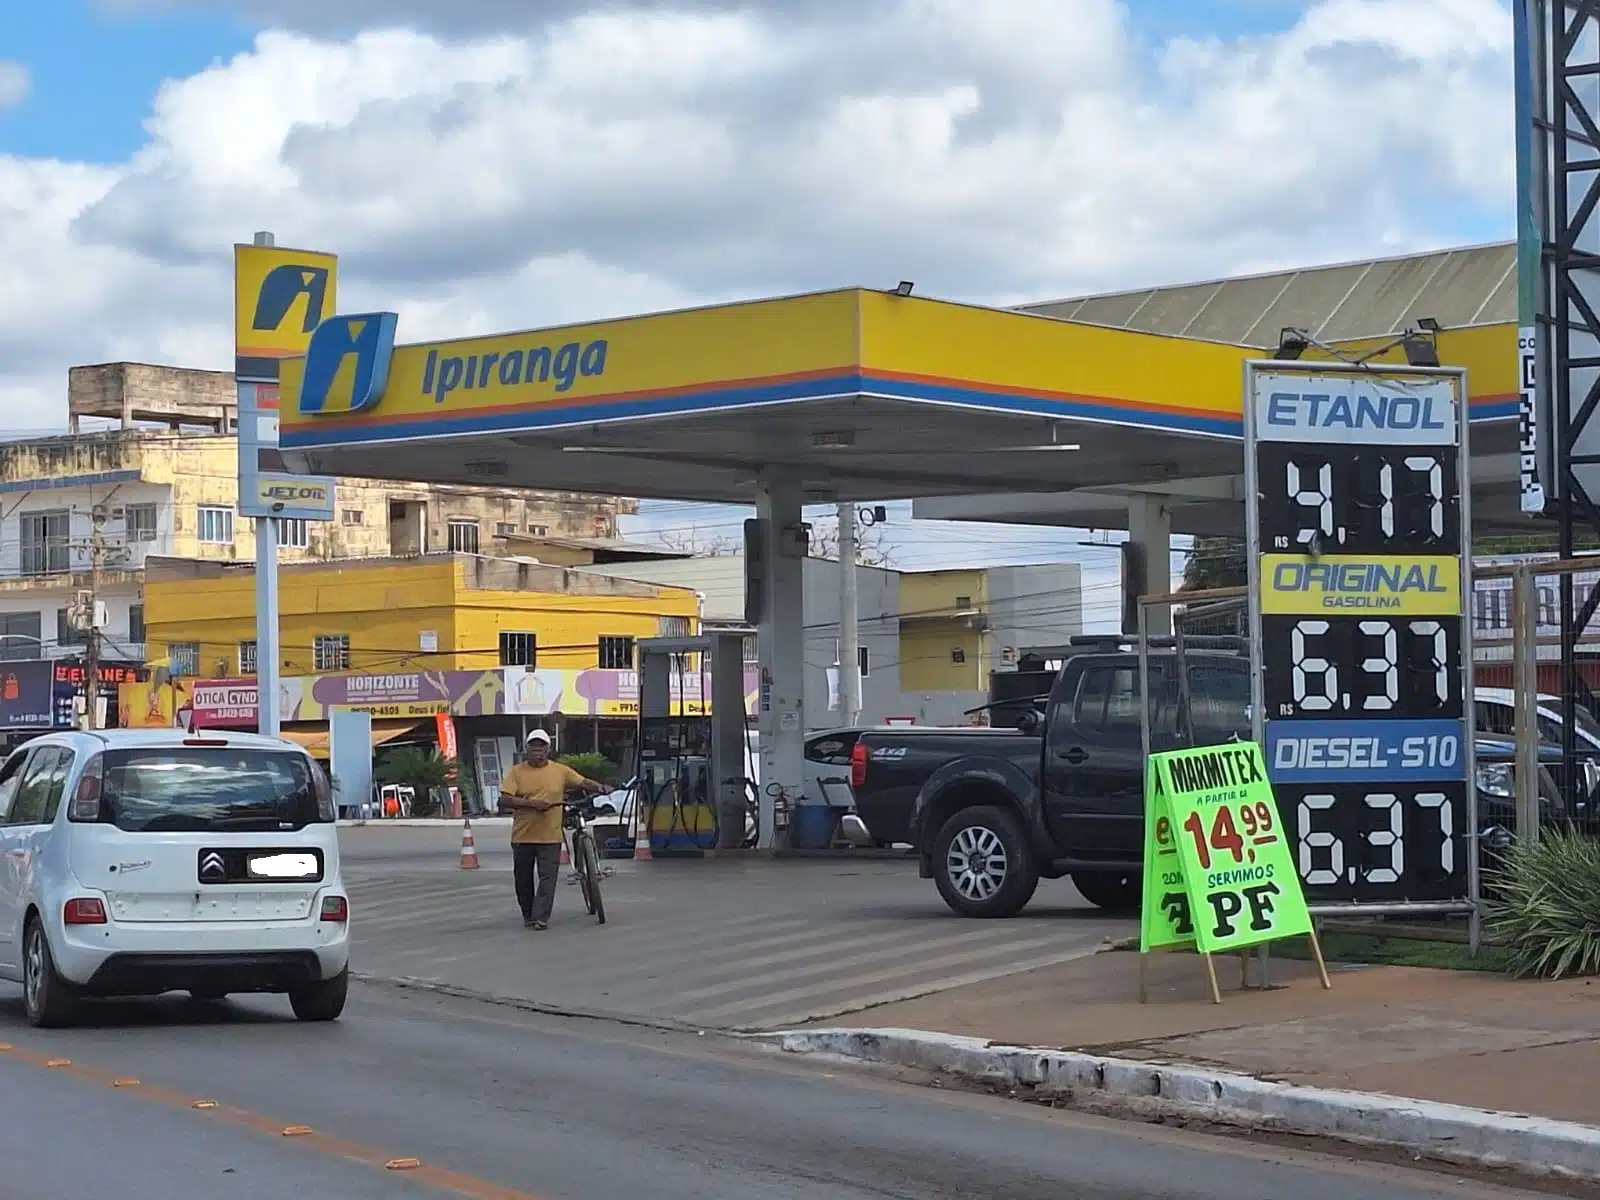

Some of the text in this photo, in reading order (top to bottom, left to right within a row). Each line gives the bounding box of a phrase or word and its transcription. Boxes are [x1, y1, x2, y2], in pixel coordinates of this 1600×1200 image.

[422, 340, 607, 403] Ipiranga
[1267, 392, 1444, 430] ETANOL
[1273, 562, 1447, 593] ORIGINAL
[1322, 596, 1401, 609] GASOLINA
[346, 674, 419, 690] HORIZONTE
[1274, 735, 1457, 769] DIESEL-S10
[1168, 750, 1263, 794] MARMITEX
[1196, 797, 1203, 807] A
[1205, 791, 1237, 805] PARTIR
[1207, 863, 1275, 889] SERVIMOS
[1206, 881, 1280, 938] PF
